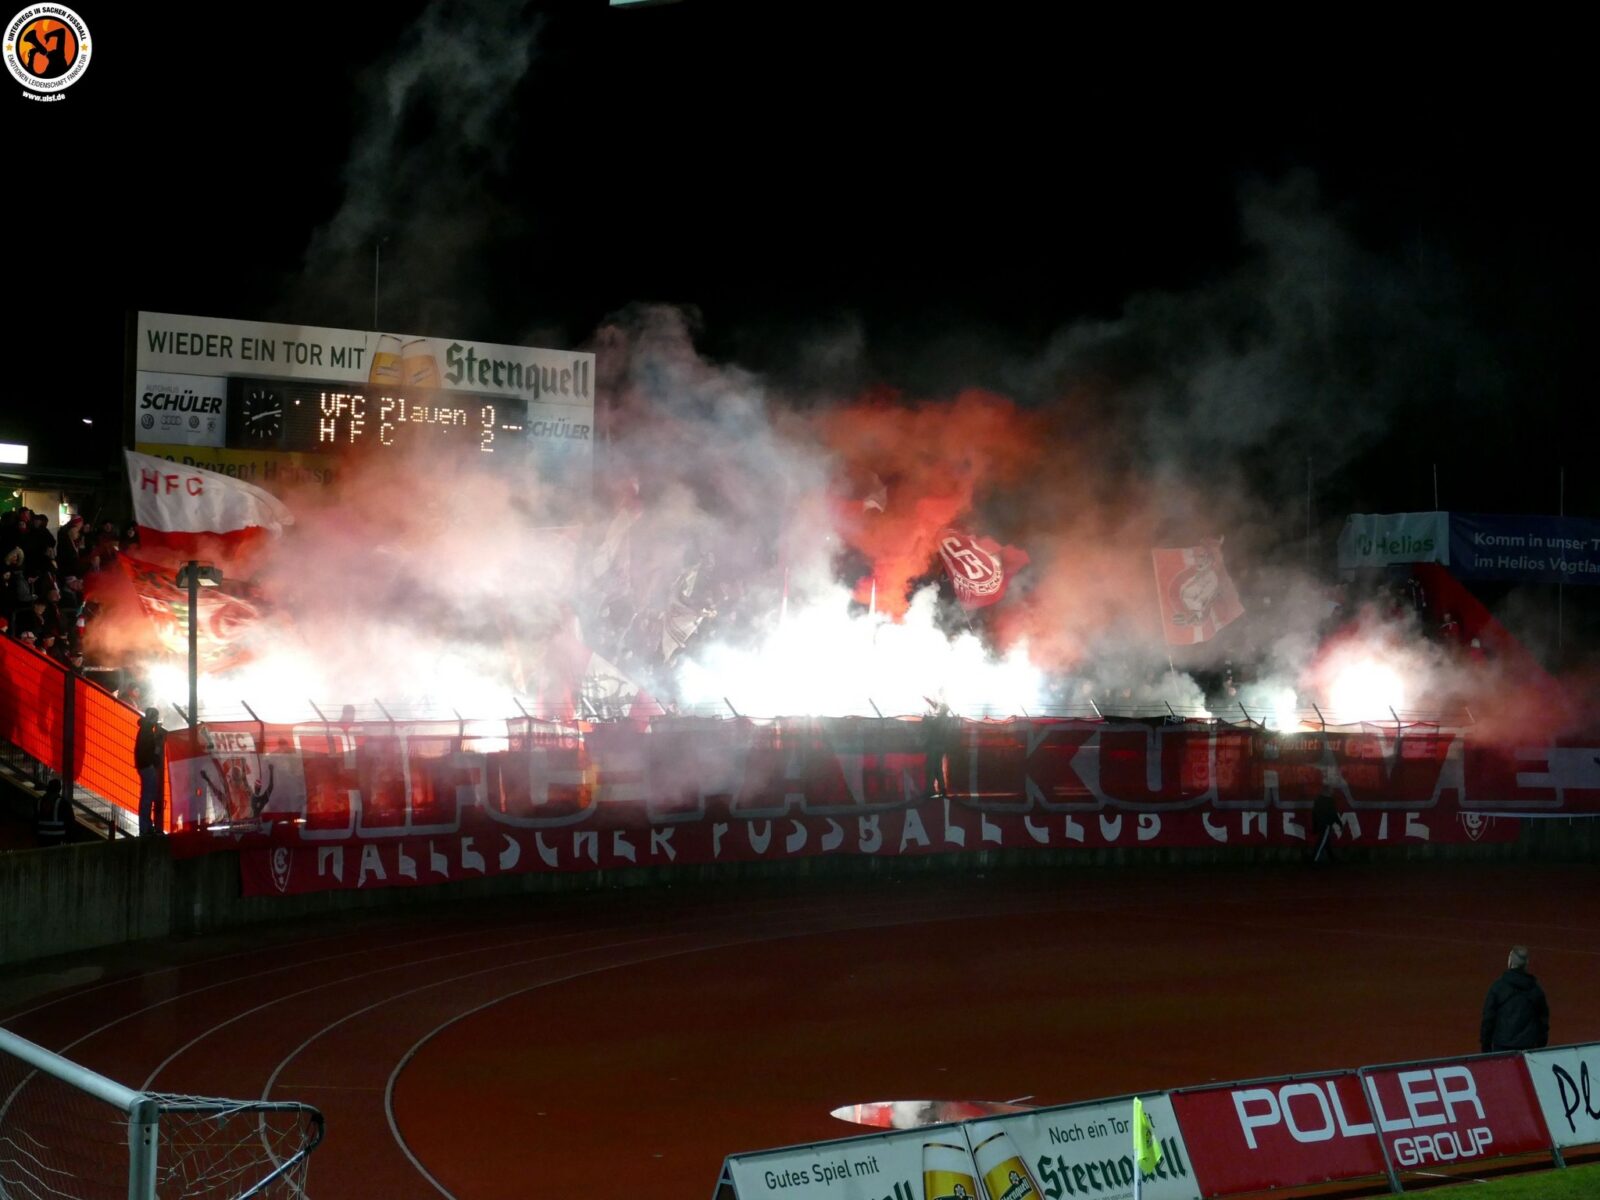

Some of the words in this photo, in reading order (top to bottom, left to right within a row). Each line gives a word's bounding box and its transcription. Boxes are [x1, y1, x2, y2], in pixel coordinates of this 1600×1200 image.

[147, 329, 234, 359] WIEDER
[240, 337, 275, 362] EIN
[283, 341, 323, 366] TOR
[330, 346, 365, 370] MIT
[445, 342, 589, 400] Sternquell
[140, 389, 223, 414] SCHÜLER
[320, 392, 366, 419] VFC
[380, 397, 467, 426] Plauen
[480, 429, 495, 452] 2
[526, 417, 591, 441] SCHÜLER
[141, 468, 204, 497] HFC
[1376, 534, 1435, 555] Helios
[1473, 531, 1525, 547] Komm
[1528, 533, 1542, 548] in
[1546, 538, 1588, 551] unser
[1474, 553, 1494, 569] im
[1497, 554, 1546, 571] Helios
[1230, 1064, 1487, 1150] POLLER
[1048, 1122, 1085, 1146] Noch
[1087, 1119, 1110, 1138] ein
[1110, 1116, 1130, 1136] Tor
[1393, 1126, 1494, 1167] GROUP
[764, 1168, 811, 1191] Gutes
[811, 1158, 853, 1187] Spiel
[853, 1155, 881, 1177] mit
[1036, 1135, 1187, 1199] Sternqell
